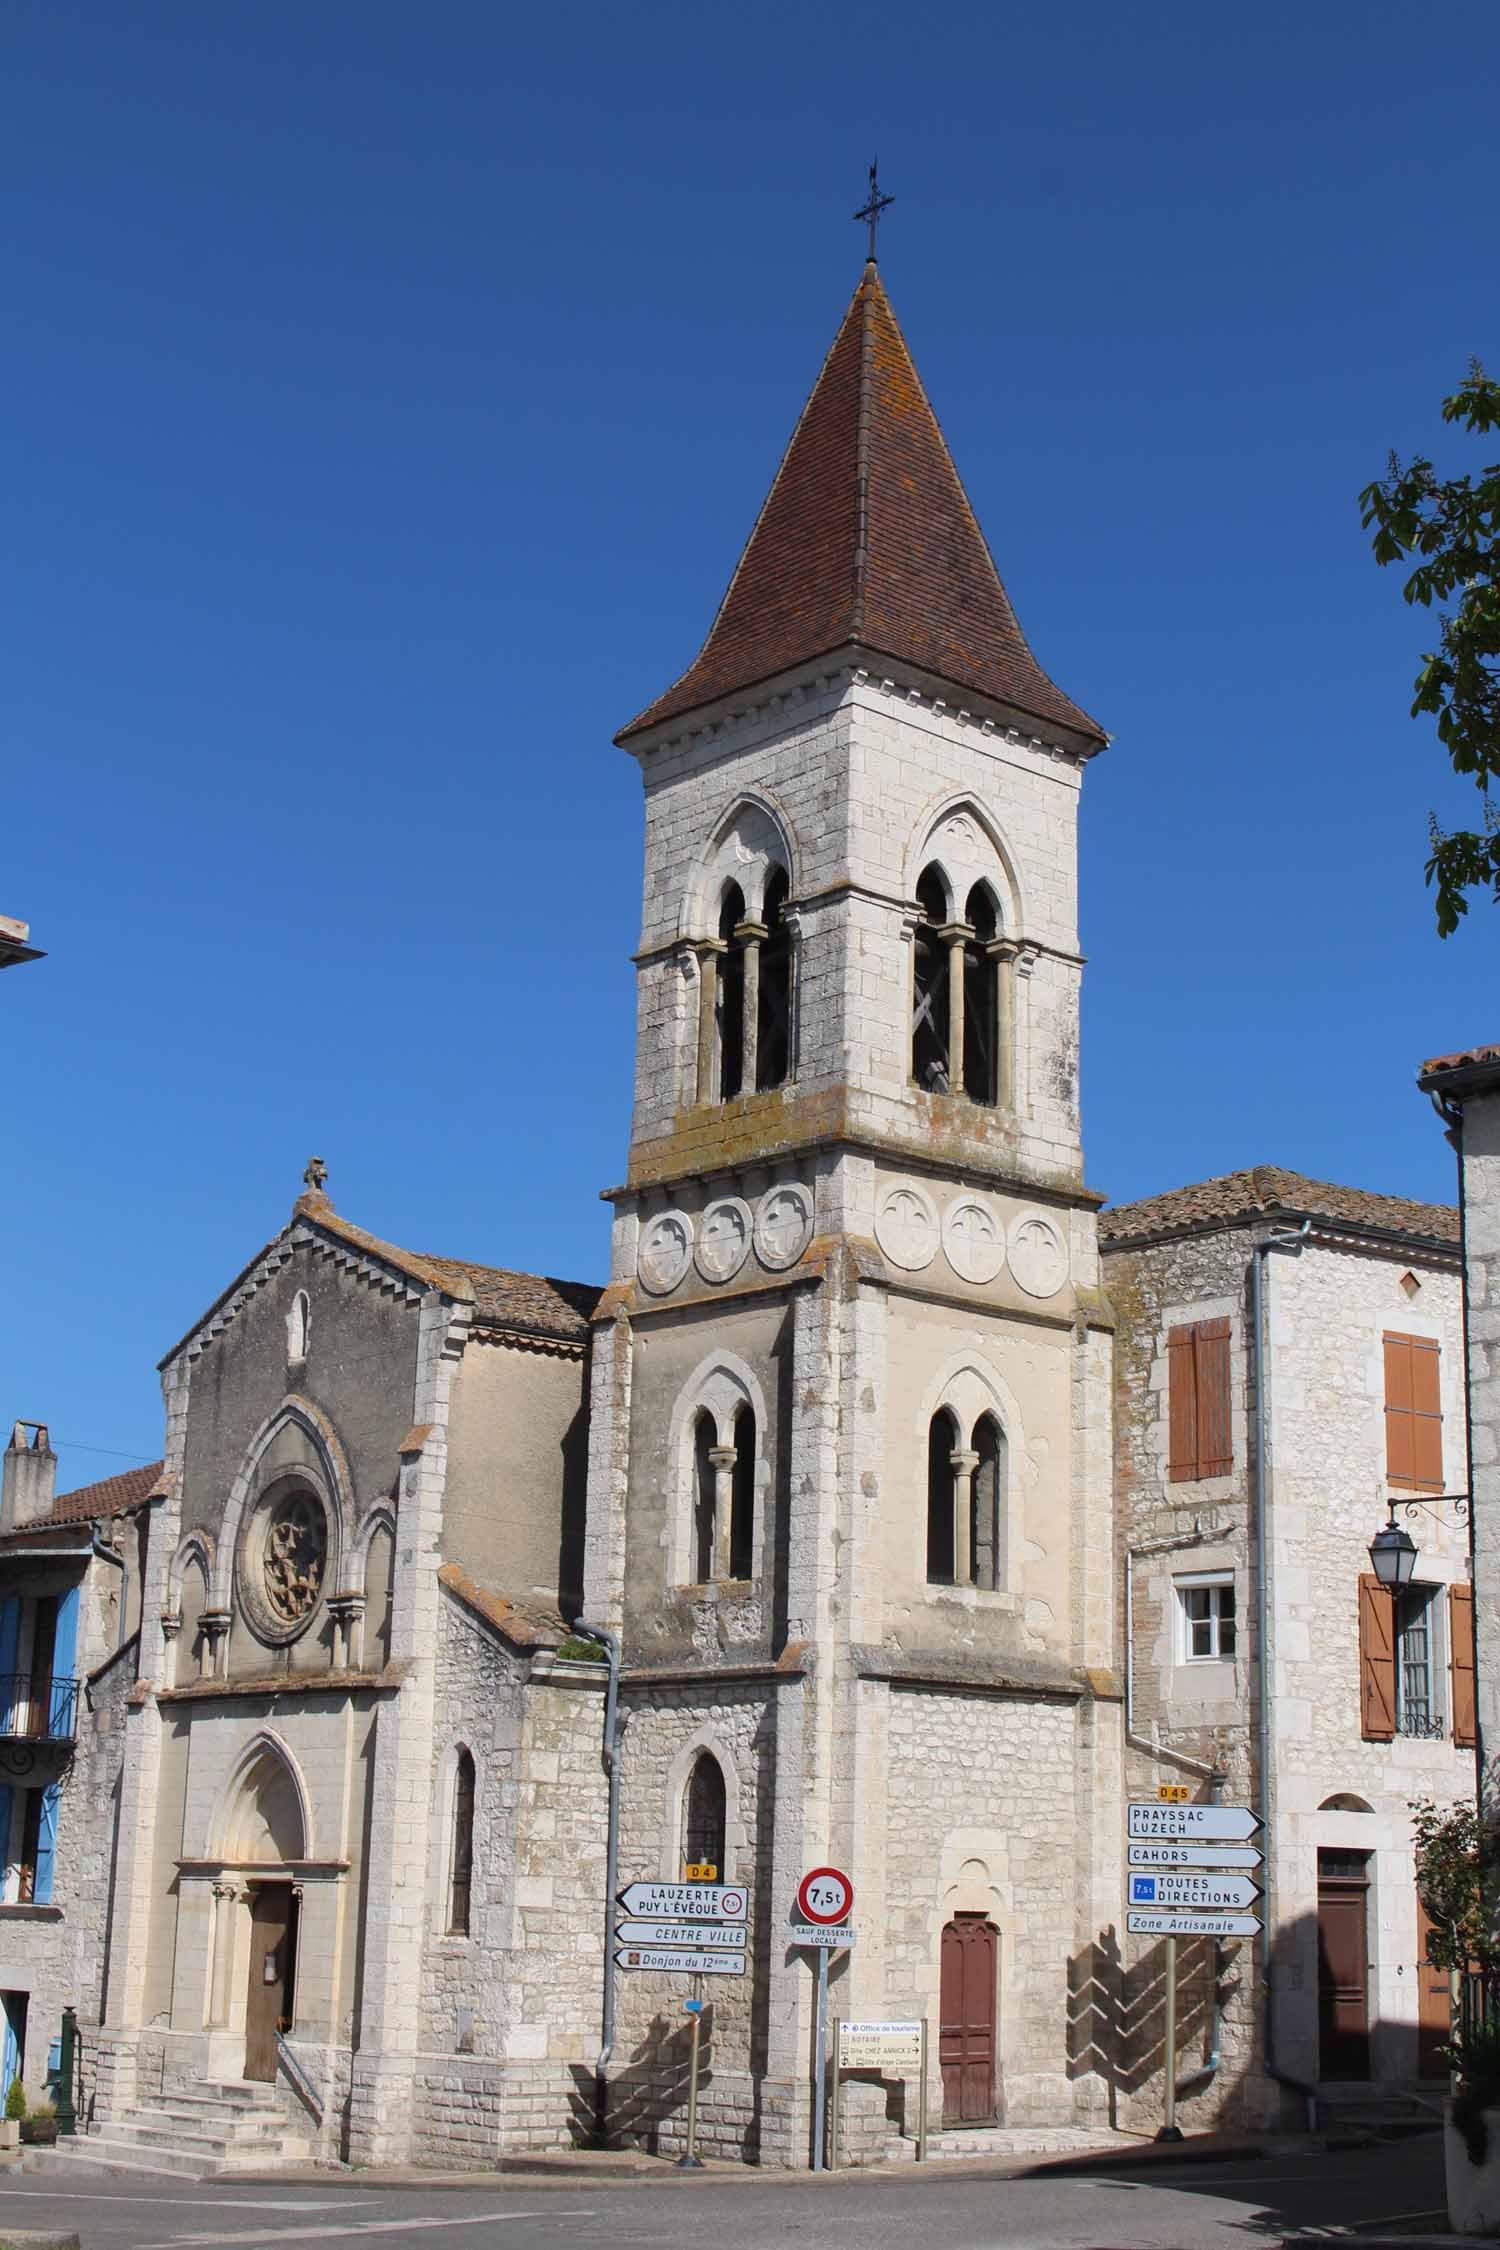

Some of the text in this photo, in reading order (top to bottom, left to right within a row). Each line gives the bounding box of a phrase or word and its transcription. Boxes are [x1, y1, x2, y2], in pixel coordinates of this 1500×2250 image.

[1160, 1788, 1188, 1798] D 45
[1133, 1809, 1204, 1821] PRAYSSAC
[1133, 1823, 1186, 1833] LUZECH
[1133, 1850, 1189, 1861] CAHORS
[692, 1867, 710, 1877] D 4
[1159, 1877, 1209, 1889] TOUTES
[651, 1888, 719, 1901] LAUZERTE
[1158, 1891, 1240, 1904] DIRECTIONS
[639, 1901, 719, 1915] PUY L'ÉVÊQUE
[1132, 1917, 1235, 1931] Zone Artisanale
[655, 1928, 743, 1943] CENTRE VILLE
[796, 1927, 854, 1937] SAUF DESSERTE
[810, 1937, 837, 1945] LOCALE
[642, 1953, 681, 1967] Donjon
[684, 1955, 698, 1968] du
[860, 2024, 920, 2032] Office de tourisme
